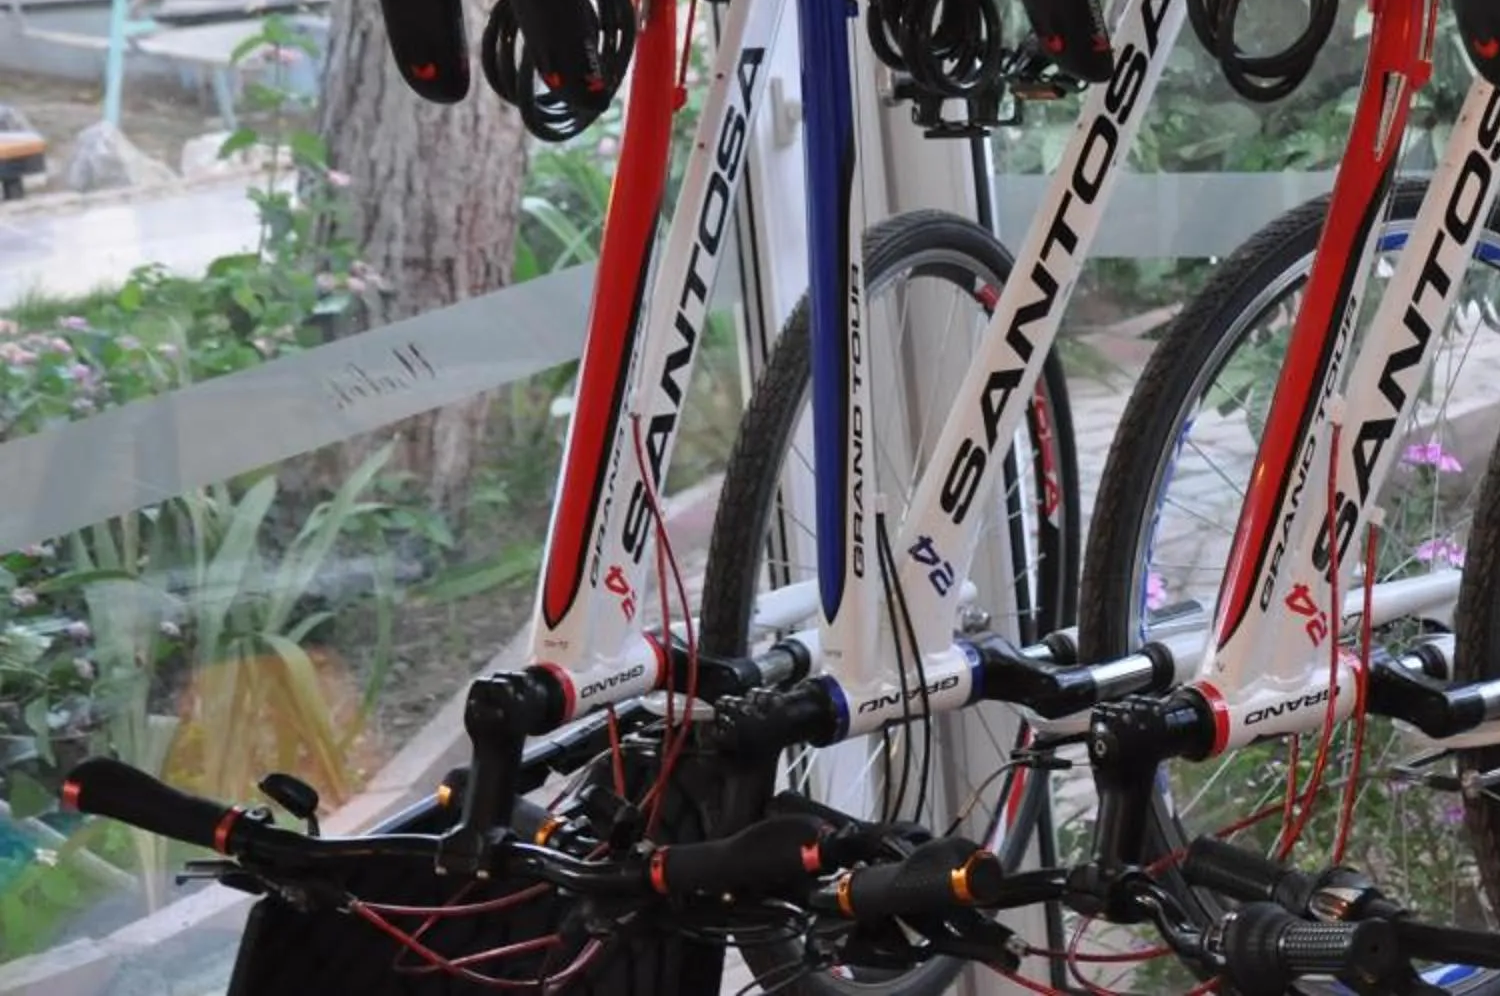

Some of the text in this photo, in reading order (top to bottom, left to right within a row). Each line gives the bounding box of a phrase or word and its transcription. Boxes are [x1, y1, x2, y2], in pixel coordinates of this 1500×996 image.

[623, 47, 764, 565] SANTOSA
[849, 263, 866, 580] GRAND TOUR
[1259, 294, 1358, 612] GRAND TOUR
[580, 664, 646, 700] GRAND
[1243, 684, 1342, 728] GRAND
